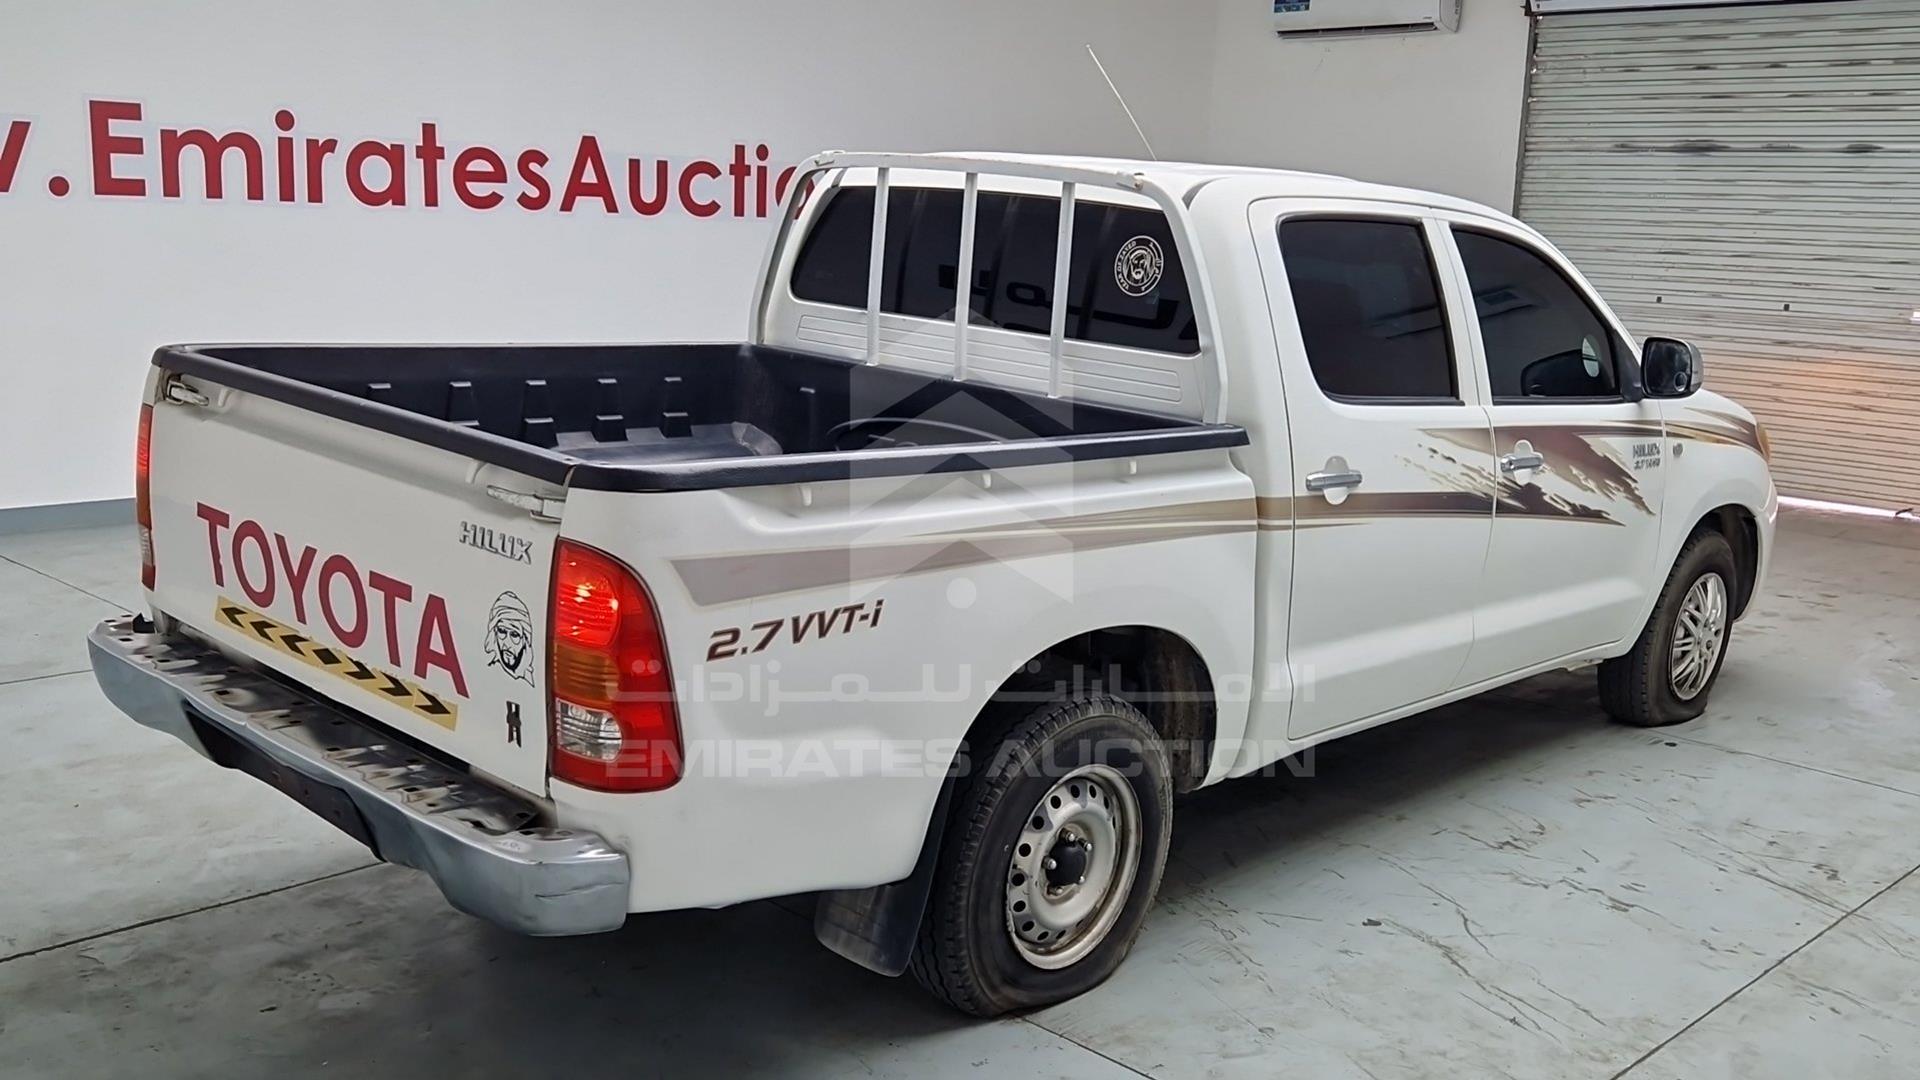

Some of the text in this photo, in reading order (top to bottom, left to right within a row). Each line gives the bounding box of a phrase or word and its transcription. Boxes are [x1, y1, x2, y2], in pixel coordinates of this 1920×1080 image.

[459, 520, 532, 565] HILUX
[196, 501, 470, 699] TOYOTA
[706, 599, 885, 663] 2.7 VVT-i
